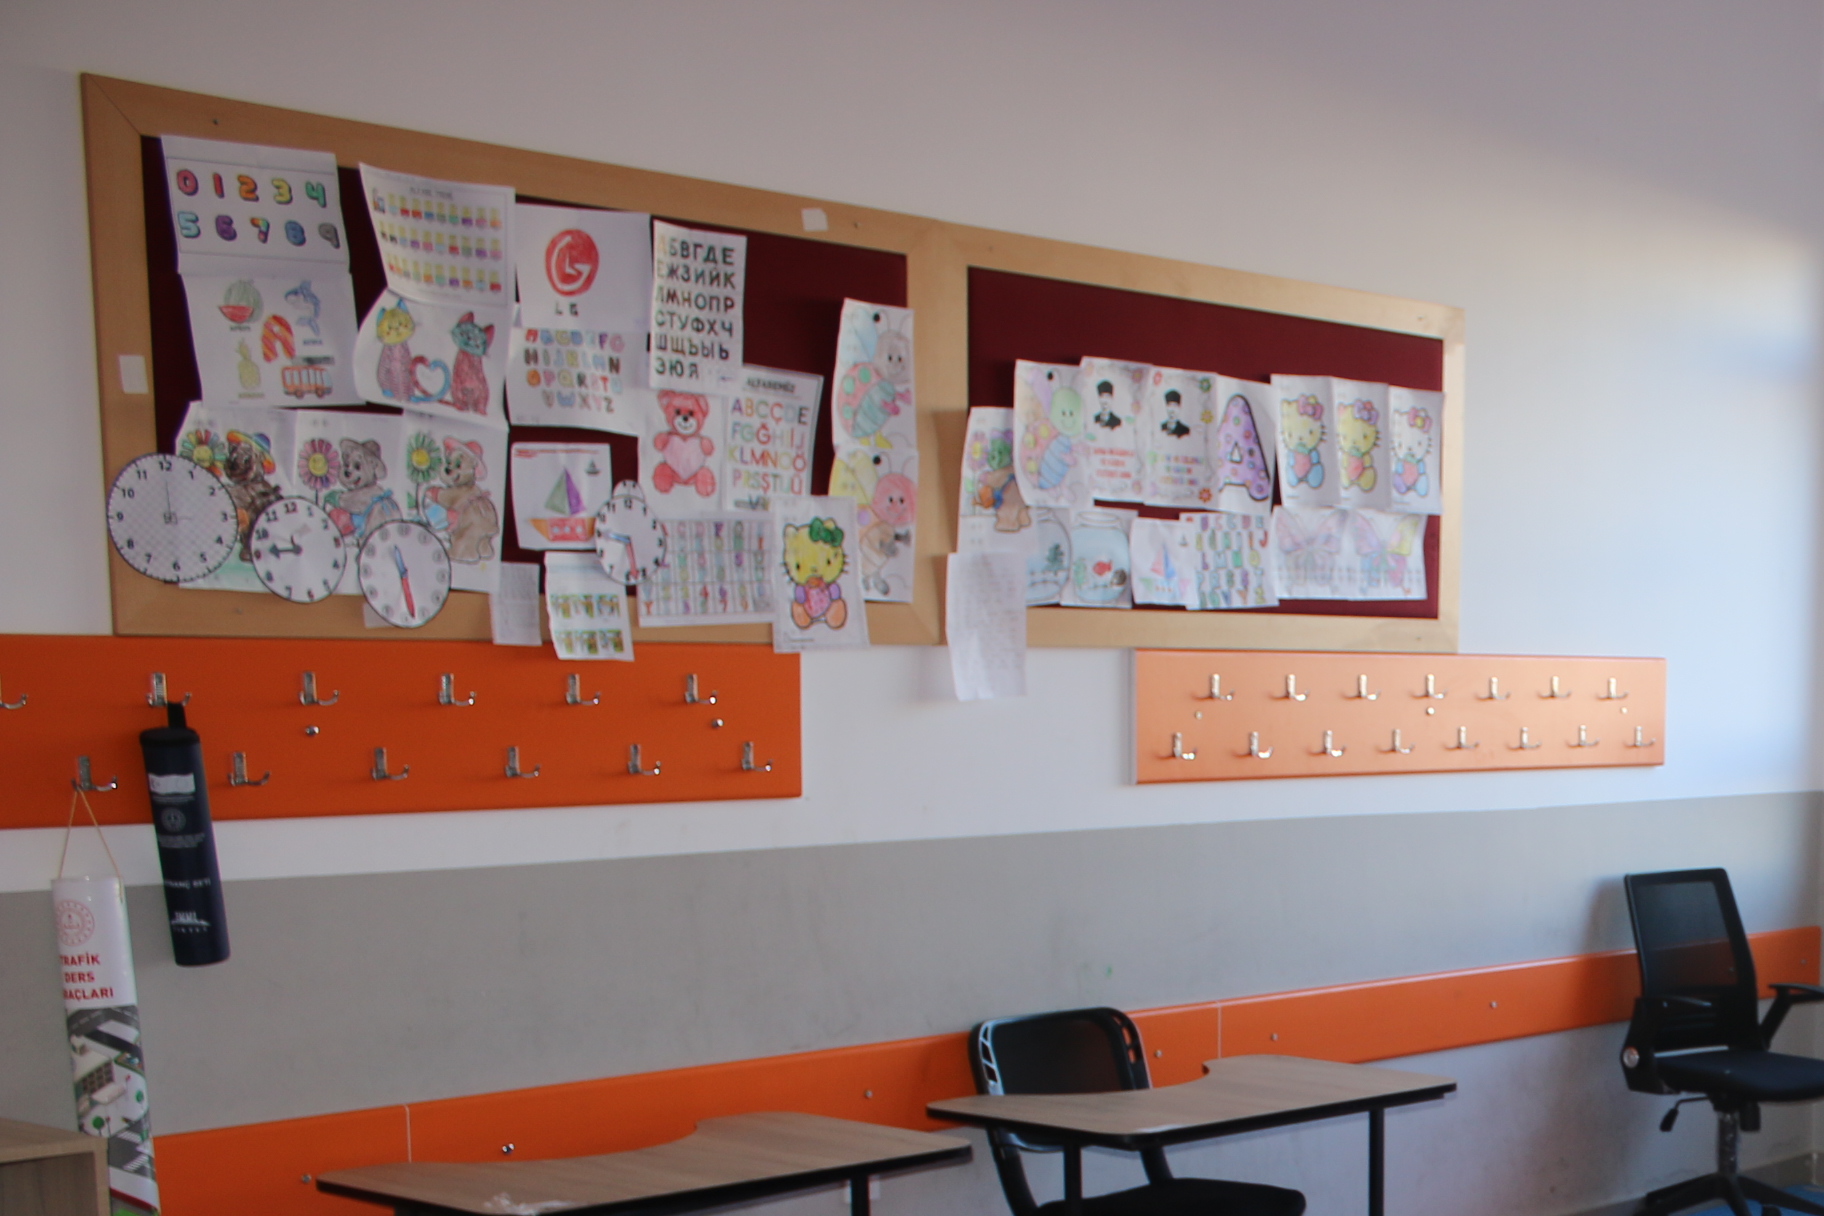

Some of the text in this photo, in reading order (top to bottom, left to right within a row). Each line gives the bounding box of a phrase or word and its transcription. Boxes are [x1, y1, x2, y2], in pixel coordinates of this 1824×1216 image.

[177, 169, 326, 208] 0 1 2 3 4
[177, 211, 340, 249] 5 6 7 8 9
[159, 461, 172, 472] 12
[137, 470, 147, 480] 11
[188, 471, 194, 479] 1
[122, 488, 134, 498] 10
[208, 486, 216, 496] 2
[116, 511, 124, 521] 9
[221, 511, 228, 522] 3
[127, 538, 134, 549] 8
[215, 535, 223, 545] 4
[145, 553, 152, 564] 7
[200, 553, 207, 562] 5
[172, 561, 180, 571] 6
[64, 971, 95, 983] DERS
